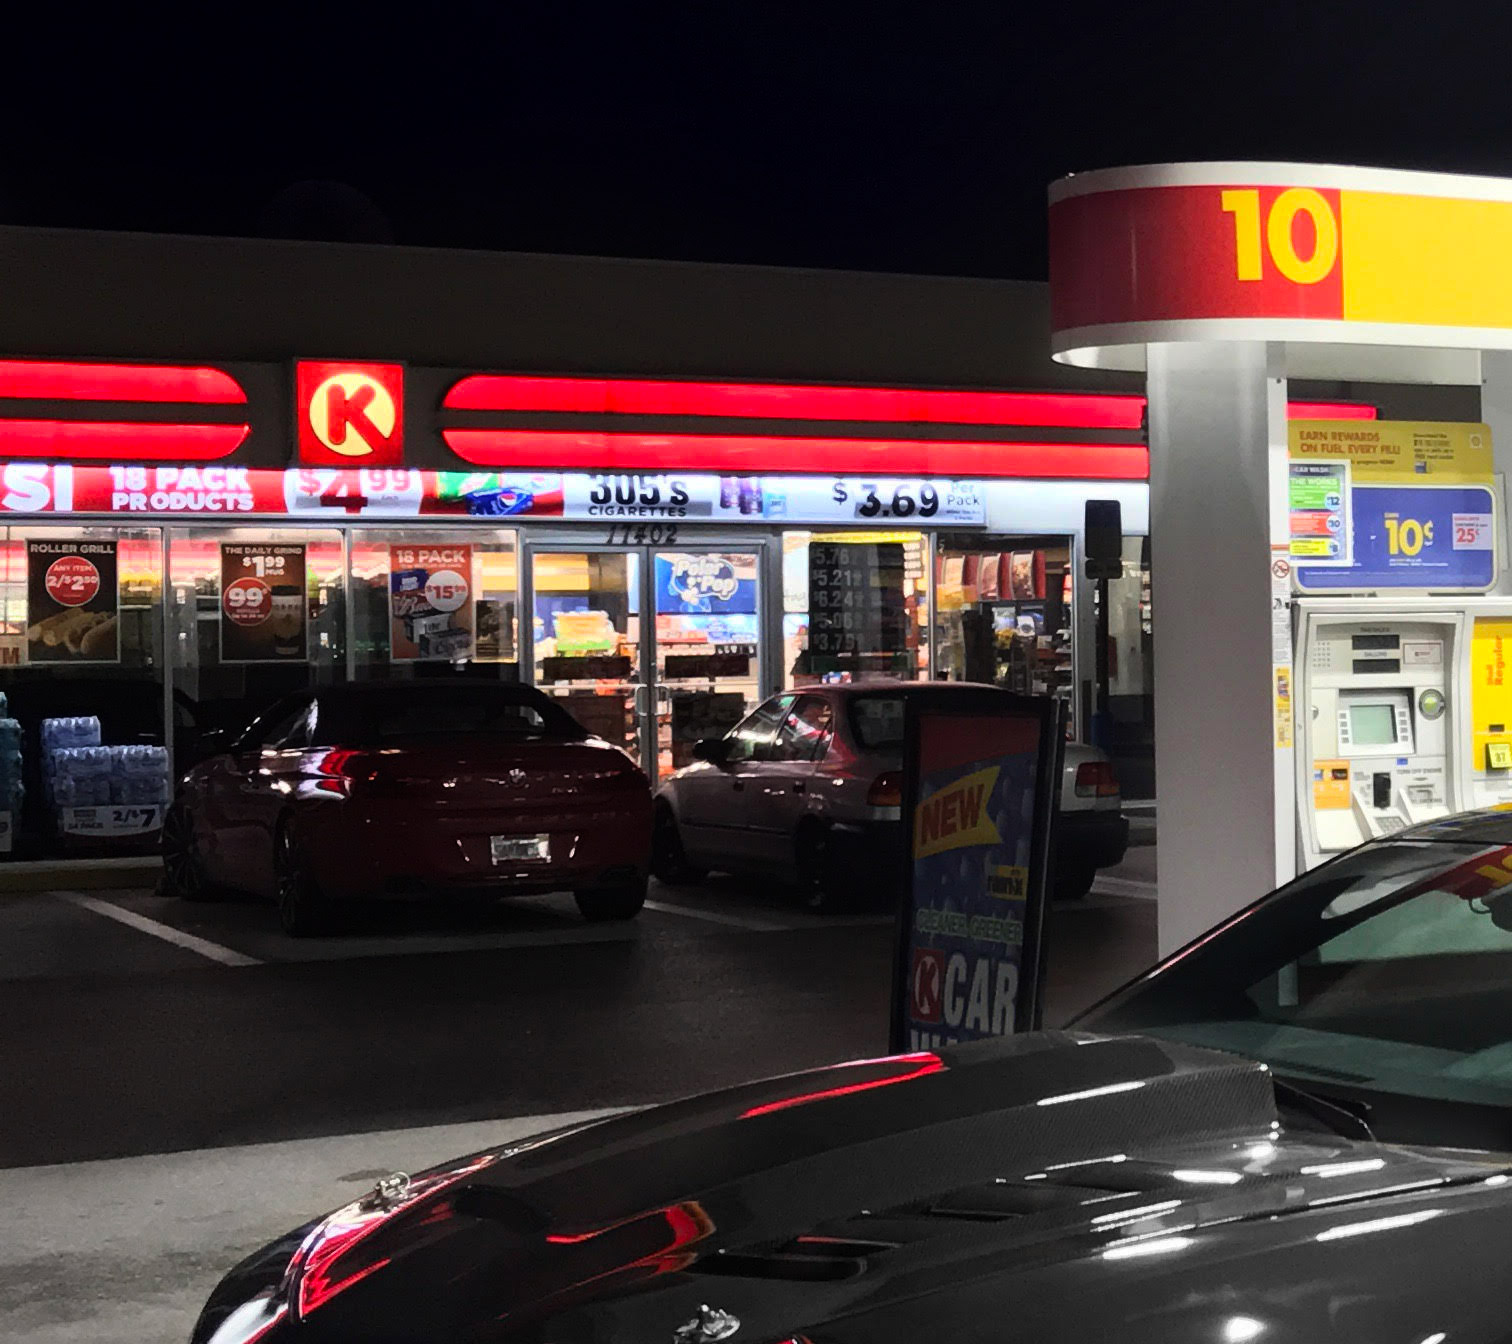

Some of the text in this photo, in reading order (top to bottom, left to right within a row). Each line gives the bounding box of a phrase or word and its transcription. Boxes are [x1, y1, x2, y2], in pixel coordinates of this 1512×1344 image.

[1222, 187, 1339, 284] 10
[326, 382, 391, 452] K
[1299, 431, 1380, 442] EARN REWARDS
[109, 466, 251, 491] 18 PACK
[111, 492, 255, 512] PRODUCTS
[587, 504, 689, 518] CIGARETTES
[858, 483, 940, 518] 3.69
[947, 495, 981, 506] Pack
[604, 523, 679, 545] 17402
[30, 543, 115, 554] ROLLER GRILL
[225, 547, 303, 555] THE DAILY GRIND
[396, 549, 466, 564] 18 PACK
[1494, 635, 1506, 686] Regular
[920, 783, 985, 845] NEW
[943, 952, 1020, 1036] CAR
